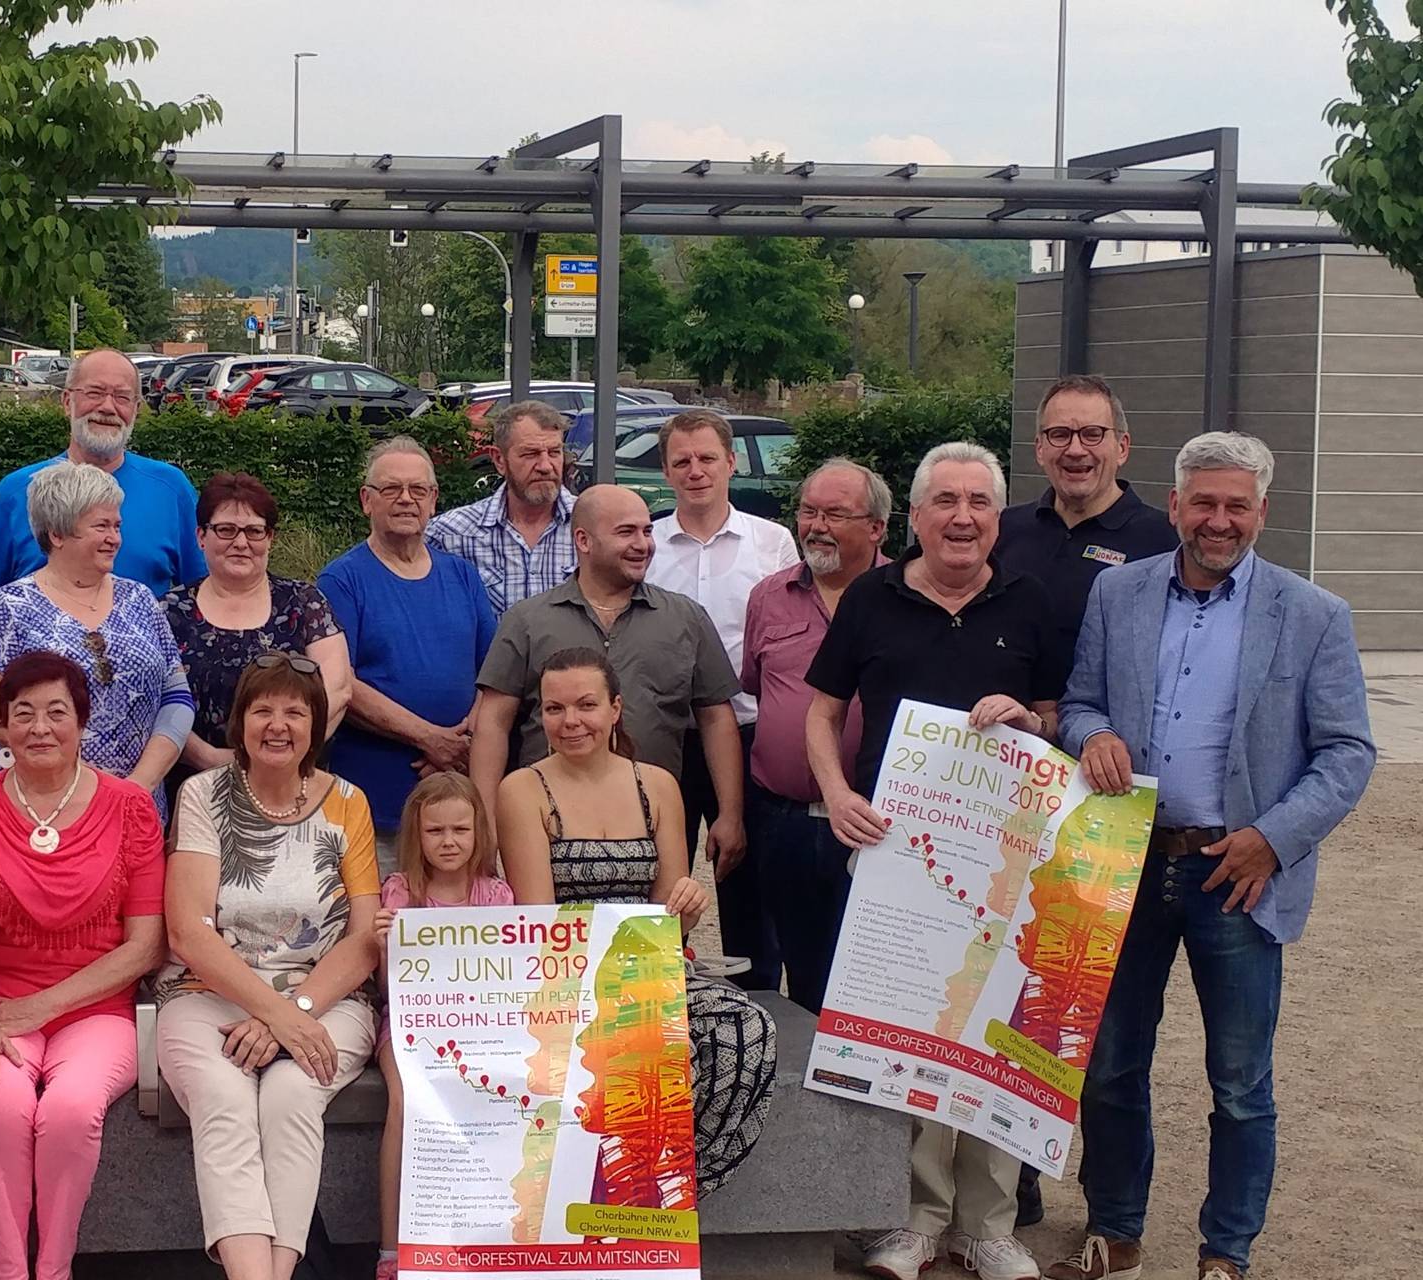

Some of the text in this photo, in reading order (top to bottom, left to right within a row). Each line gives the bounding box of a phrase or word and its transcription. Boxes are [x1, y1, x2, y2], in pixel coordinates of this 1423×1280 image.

[903, 709, 1069, 789] Lennesingt
[887, 779, 919, 797] 11:00
[922, 788, 952, 805] UHR
[891, 747, 1062, 818] 29. JUNI 2019
[881, 797, 1048, 863] ISERLOHN-LETMATHE
[399, 915, 588, 951] Lennesingt
[399, 955, 589, 983] 29. JUNI 2019
[399, 990, 591, 1006] 11:00 UHR LETNETTI PLATZ
[399, 1010, 591, 1028] ISERLOHN-LETMATHE
[834, 1018, 863, 1037] DAS
[867, 1025, 969, 1066] CHORFESTIVAL
[970, 1056, 999, 1079] ZUM
[1001, 1070, 1063, 1112] MITSINGEN
[951, 1091, 984, 1109] LOBBE
[595, 1209, 678, 1224] Chorbühne NRW
[579, 1222, 644, 1236] ChorVerband
[646, 1226, 673, 1238] NRW
[413, 1249, 680, 1266] DAS CHORFESTIVAL ZUM MITSINGEN
